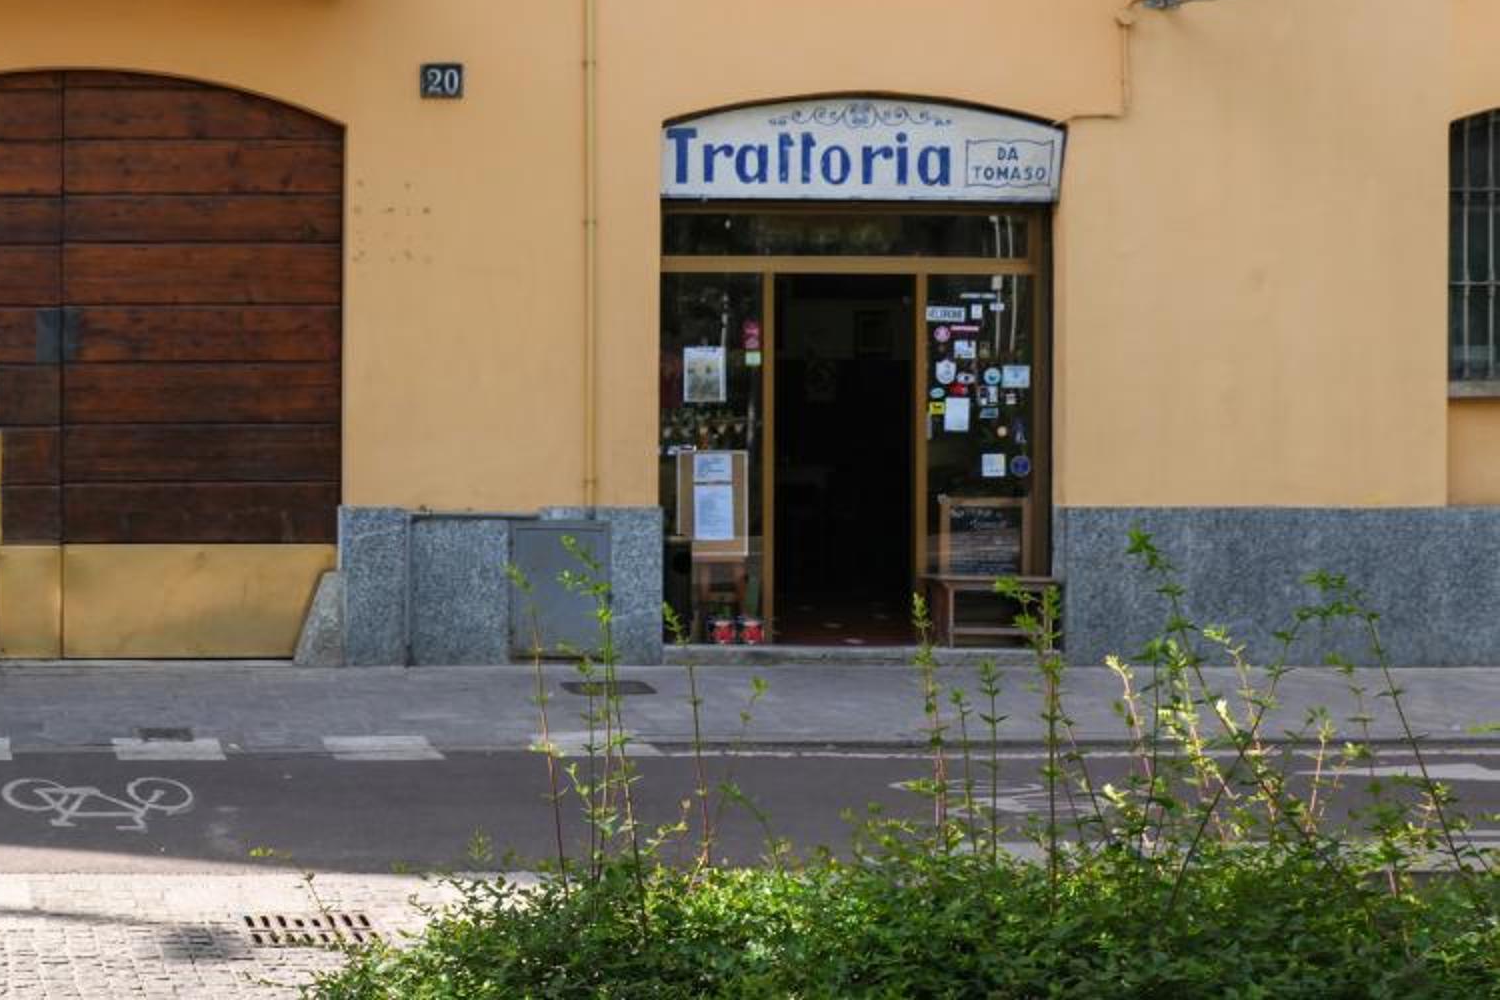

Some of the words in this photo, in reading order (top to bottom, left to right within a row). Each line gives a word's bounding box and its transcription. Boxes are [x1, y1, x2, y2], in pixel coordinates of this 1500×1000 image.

[427, 68, 460, 96] 20
[665, 127, 952, 187] Trattoria
[996, 146, 1019, 162] DA
[971, 164, 1046, 182] TOMASO
